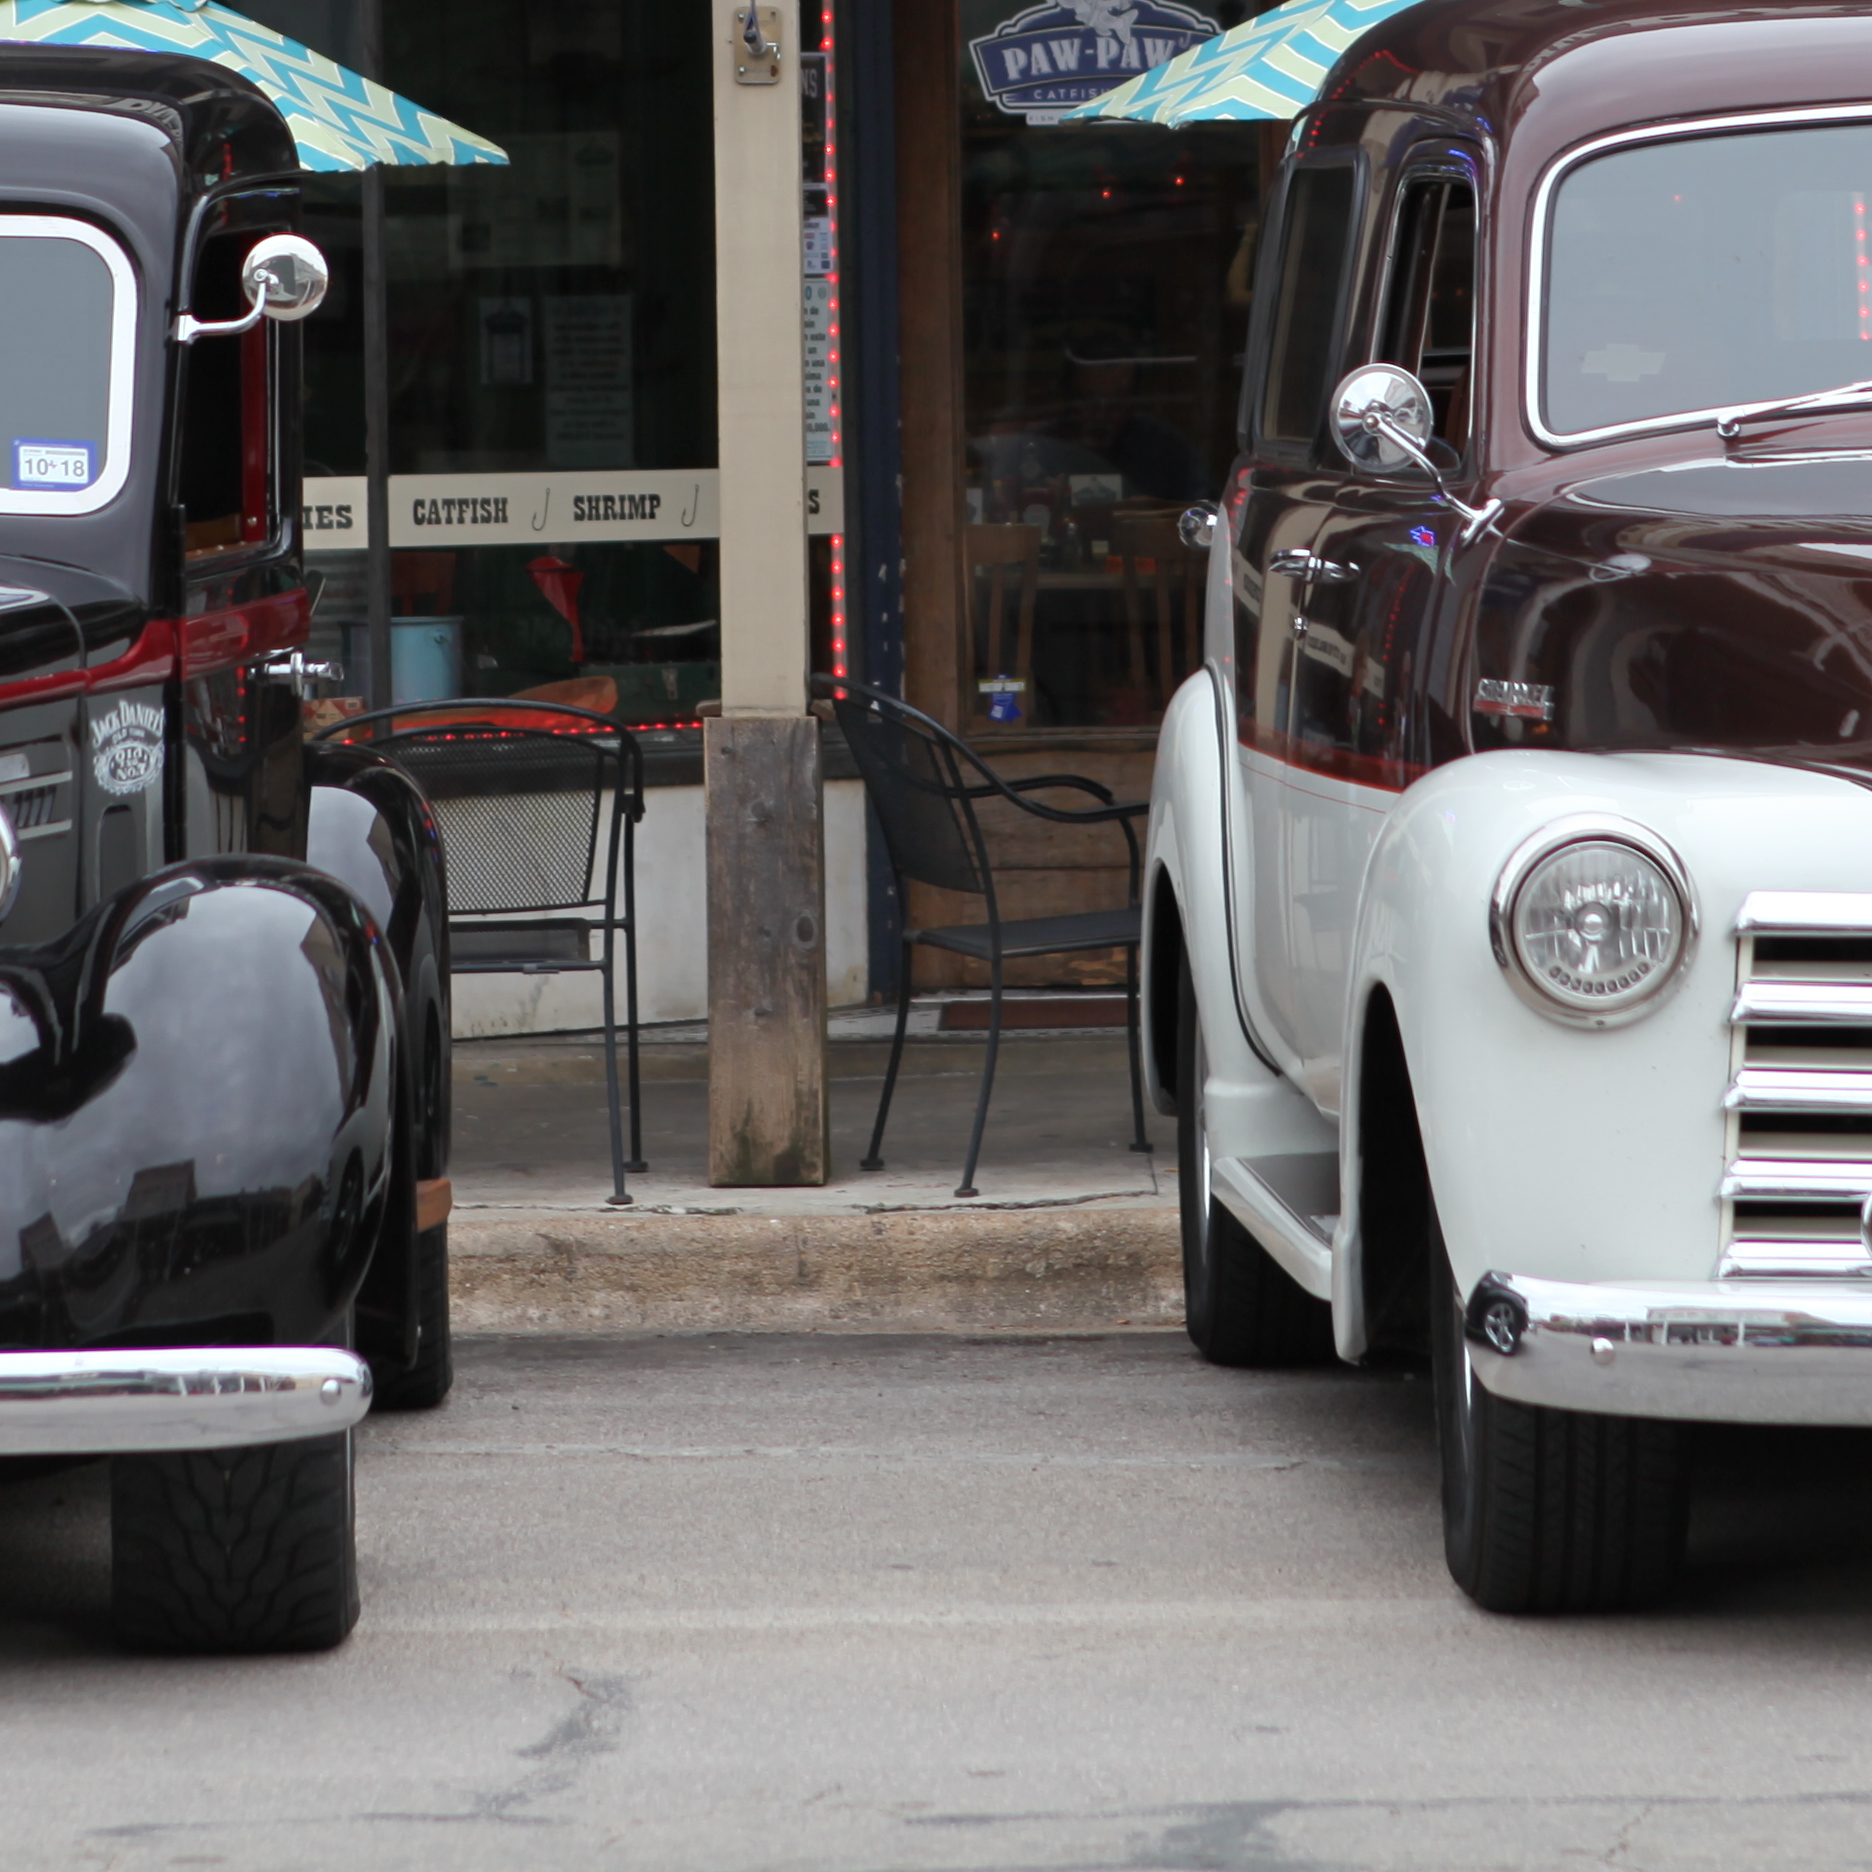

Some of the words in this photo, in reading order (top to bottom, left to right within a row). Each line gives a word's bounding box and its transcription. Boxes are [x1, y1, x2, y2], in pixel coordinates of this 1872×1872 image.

[24, 457, 49, 476] 10
[60, 459, 85, 478] 18
[412, 497, 509, 526] CATFISH
[572, 493, 662, 522] SHRIMP
